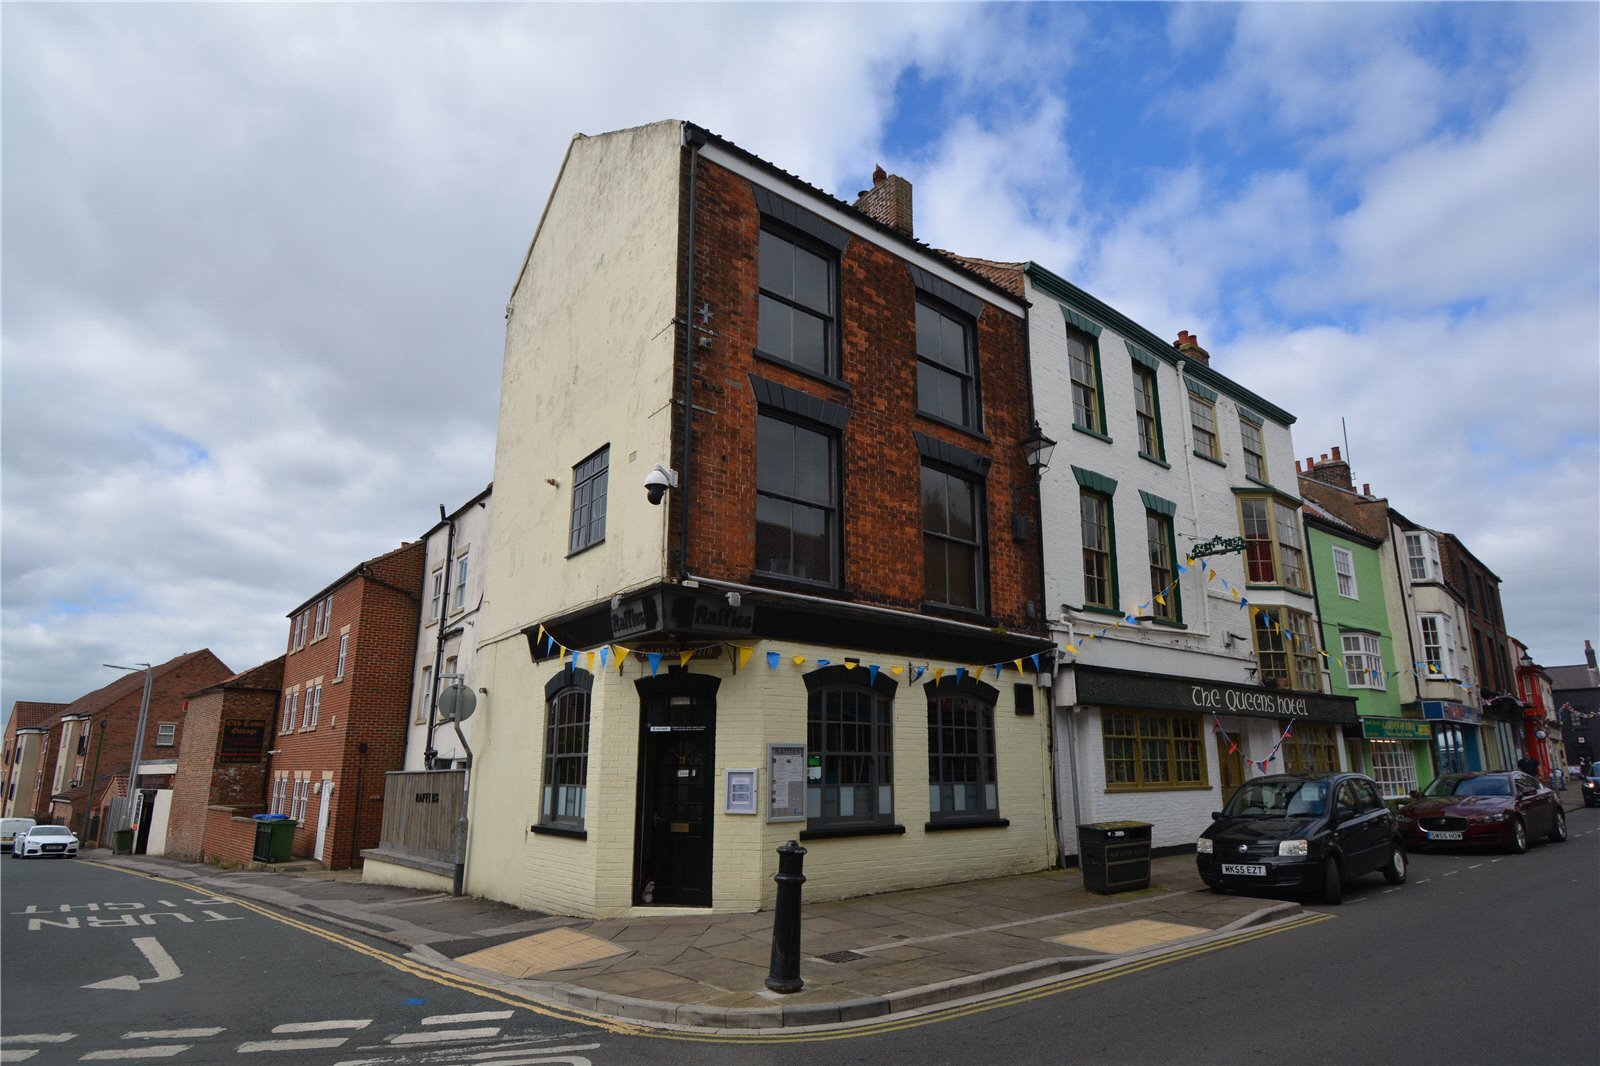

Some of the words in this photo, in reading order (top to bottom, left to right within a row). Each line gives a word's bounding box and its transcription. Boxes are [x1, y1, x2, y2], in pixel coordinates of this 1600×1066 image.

[611, 609, 645, 632] Raffles
[695, 604, 752, 628] Raffles
[1246, 866, 1263, 875] EZT
[28, 909, 245, 931] TURN
